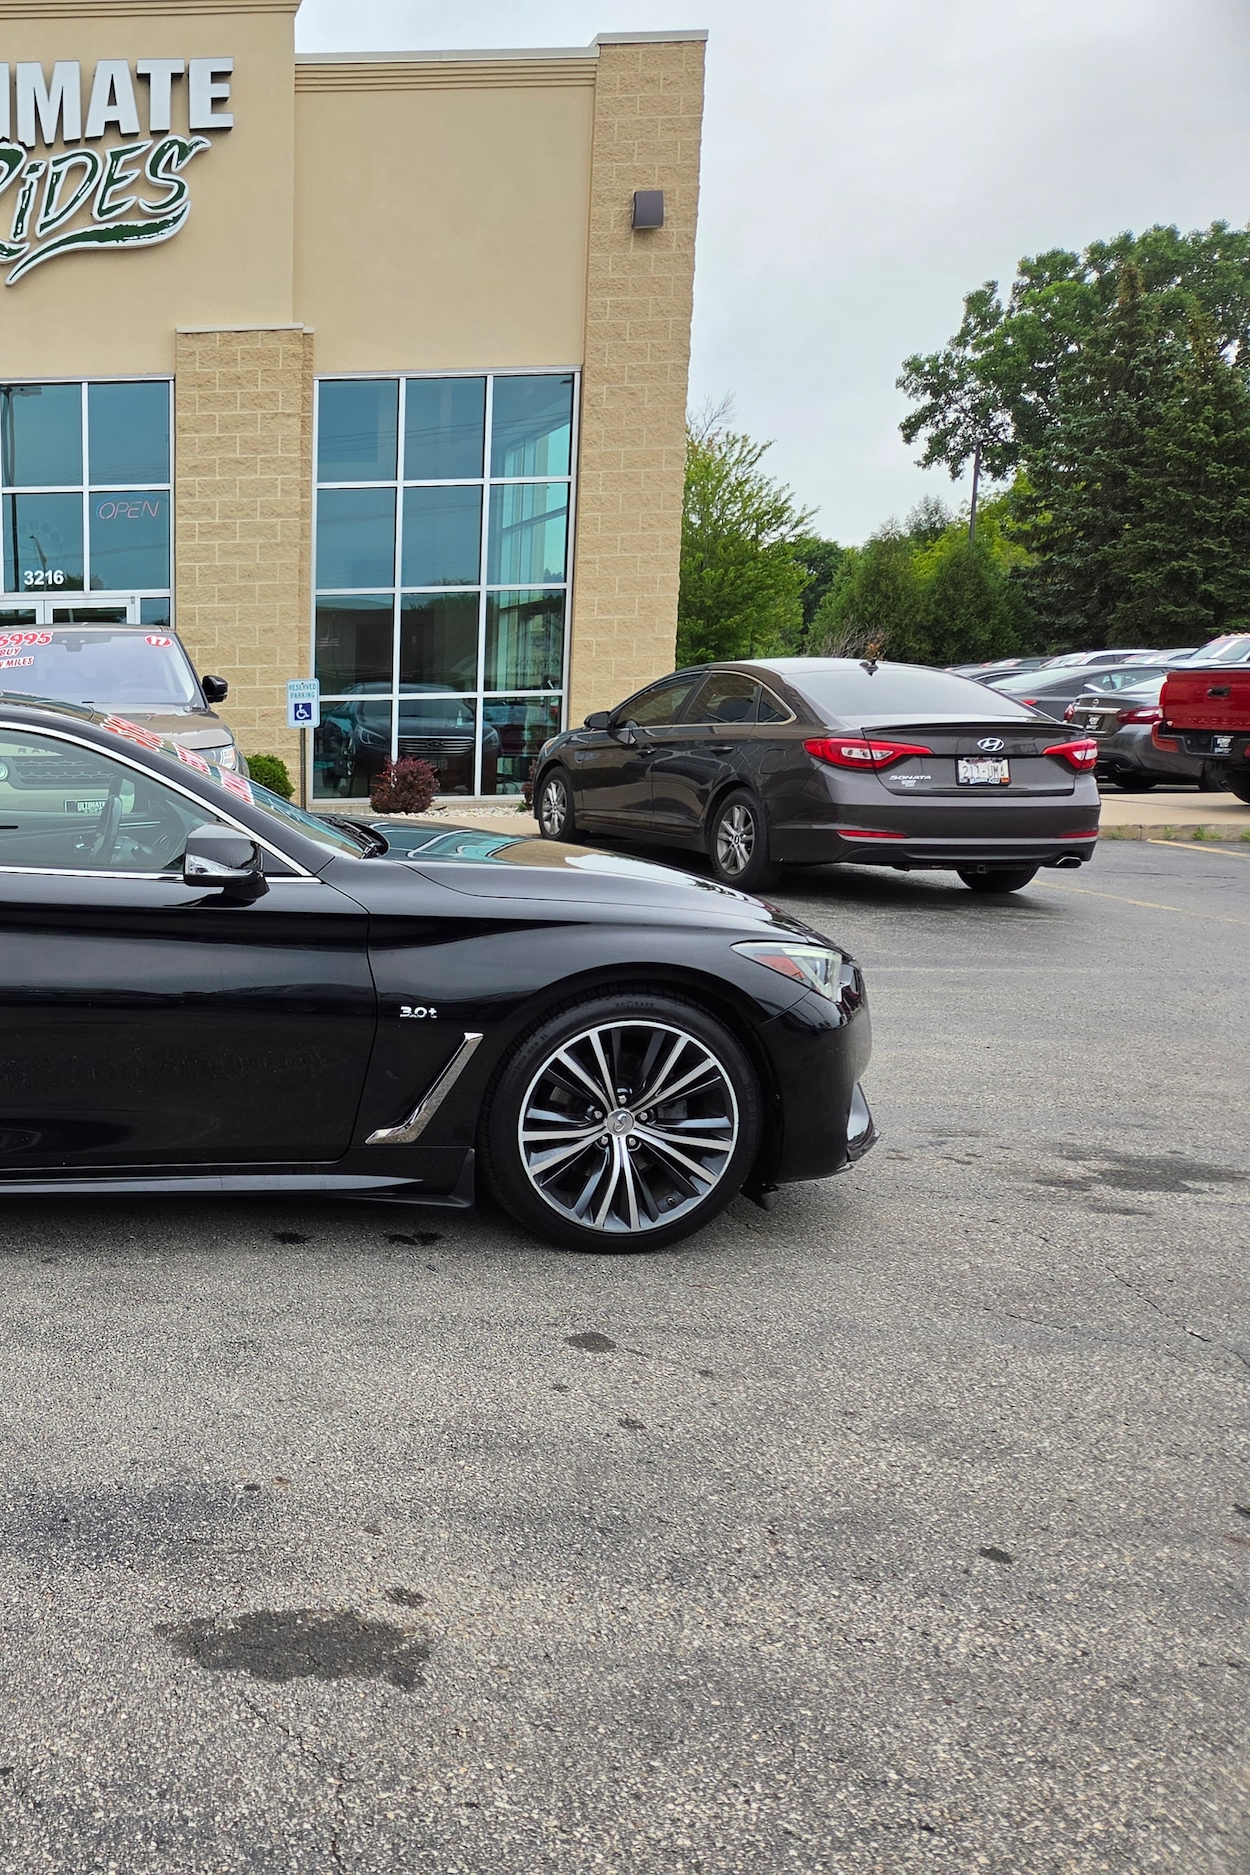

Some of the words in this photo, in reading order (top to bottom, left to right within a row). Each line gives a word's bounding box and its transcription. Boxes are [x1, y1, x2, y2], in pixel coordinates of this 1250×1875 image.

[98, 501, 160, 519] OPEN
[23, 569, 65, 586] 3216
[148, 636, 168, 646] 17
[6, 656, 34, 669] MILES
[288, 683, 317, 691] RESERVED
[290, 691, 315, 699] PARKING
